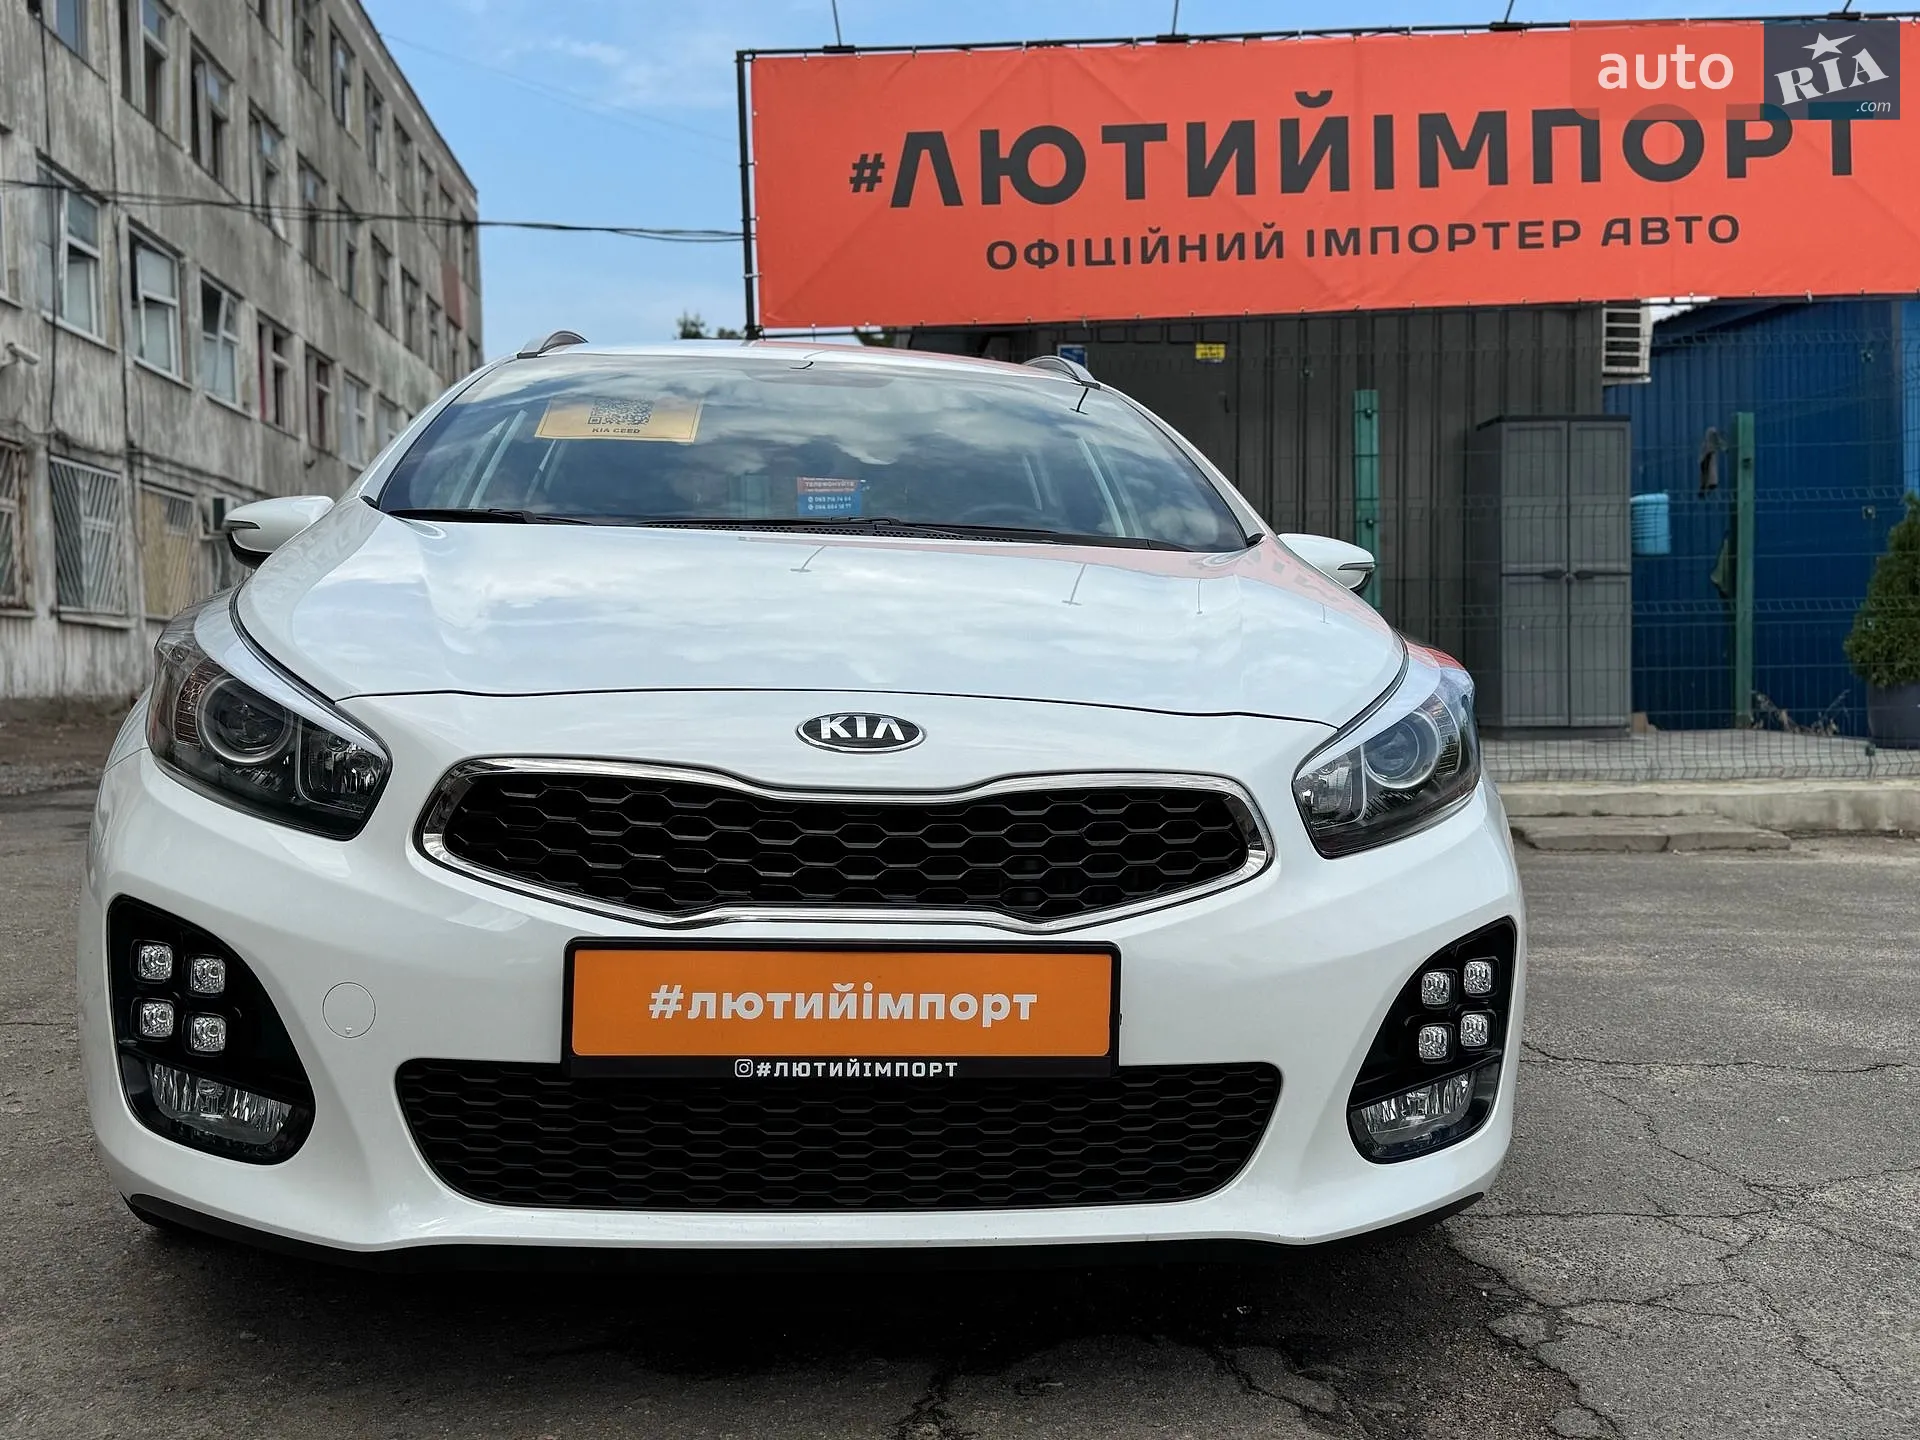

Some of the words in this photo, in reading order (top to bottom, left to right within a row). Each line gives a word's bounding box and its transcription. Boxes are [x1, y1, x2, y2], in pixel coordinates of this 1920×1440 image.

[849, 90, 1874, 208] #ЛЮТИЙІМПОРТ
[986, 222, 1284, 270] ОФІЦІЙНИЙ
[1307, 219, 1581, 258] ІМПОРТЕР
[1601, 214, 1739, 246] АВТО
[820, 716, 905, 742] KIA
[648, 982, 1038, 1028] #лютийімпорт
[756, 1058, 958, 1078] #ЛЮТИЙІМПОРТ
